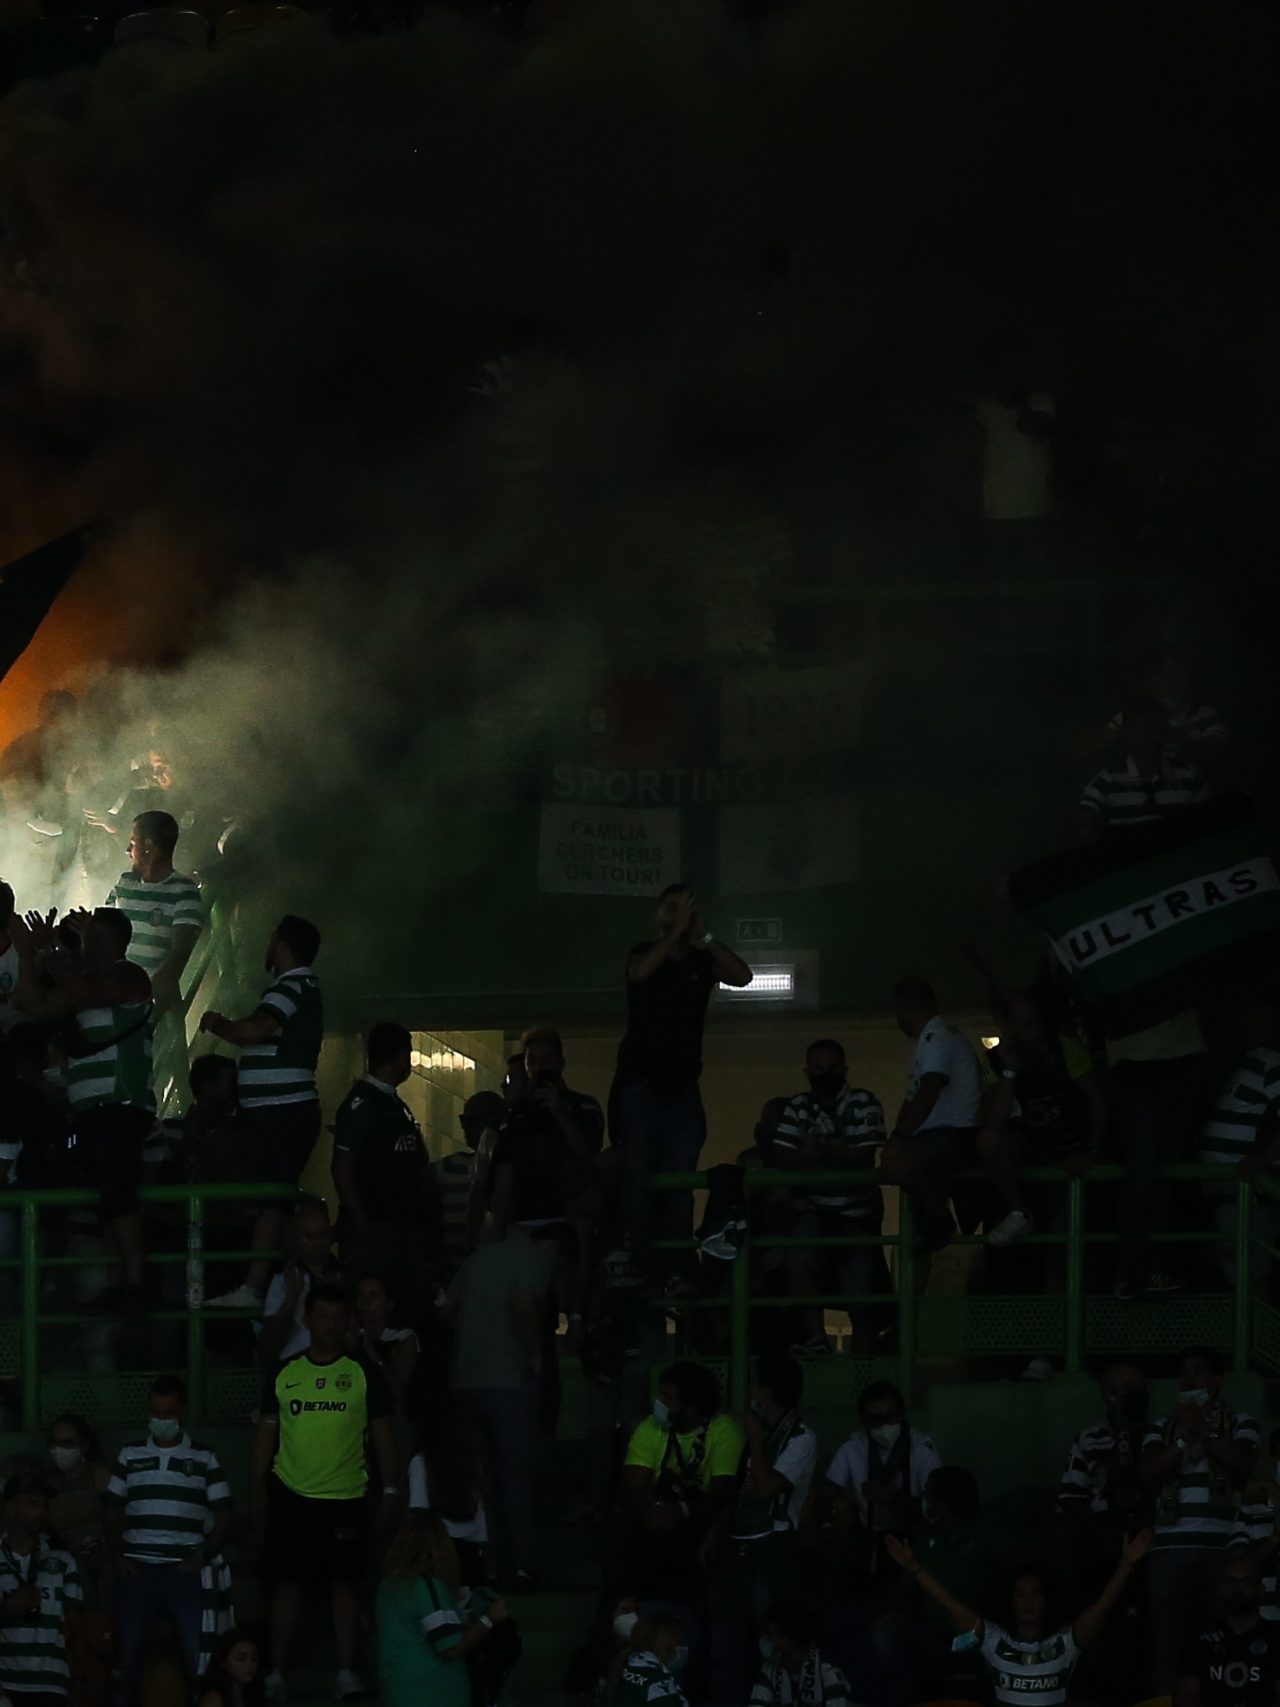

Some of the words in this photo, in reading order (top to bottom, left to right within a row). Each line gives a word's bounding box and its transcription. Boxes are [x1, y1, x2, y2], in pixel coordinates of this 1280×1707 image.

[552, 764, 763, 803] SPORTING
[565, 864, 592, 882] ON
[1069, 869, 1258, 962] ULTRAS
[304, 1401, 347, 1412] BETANO
[1209, 1661, 1261, 1689] NOS
